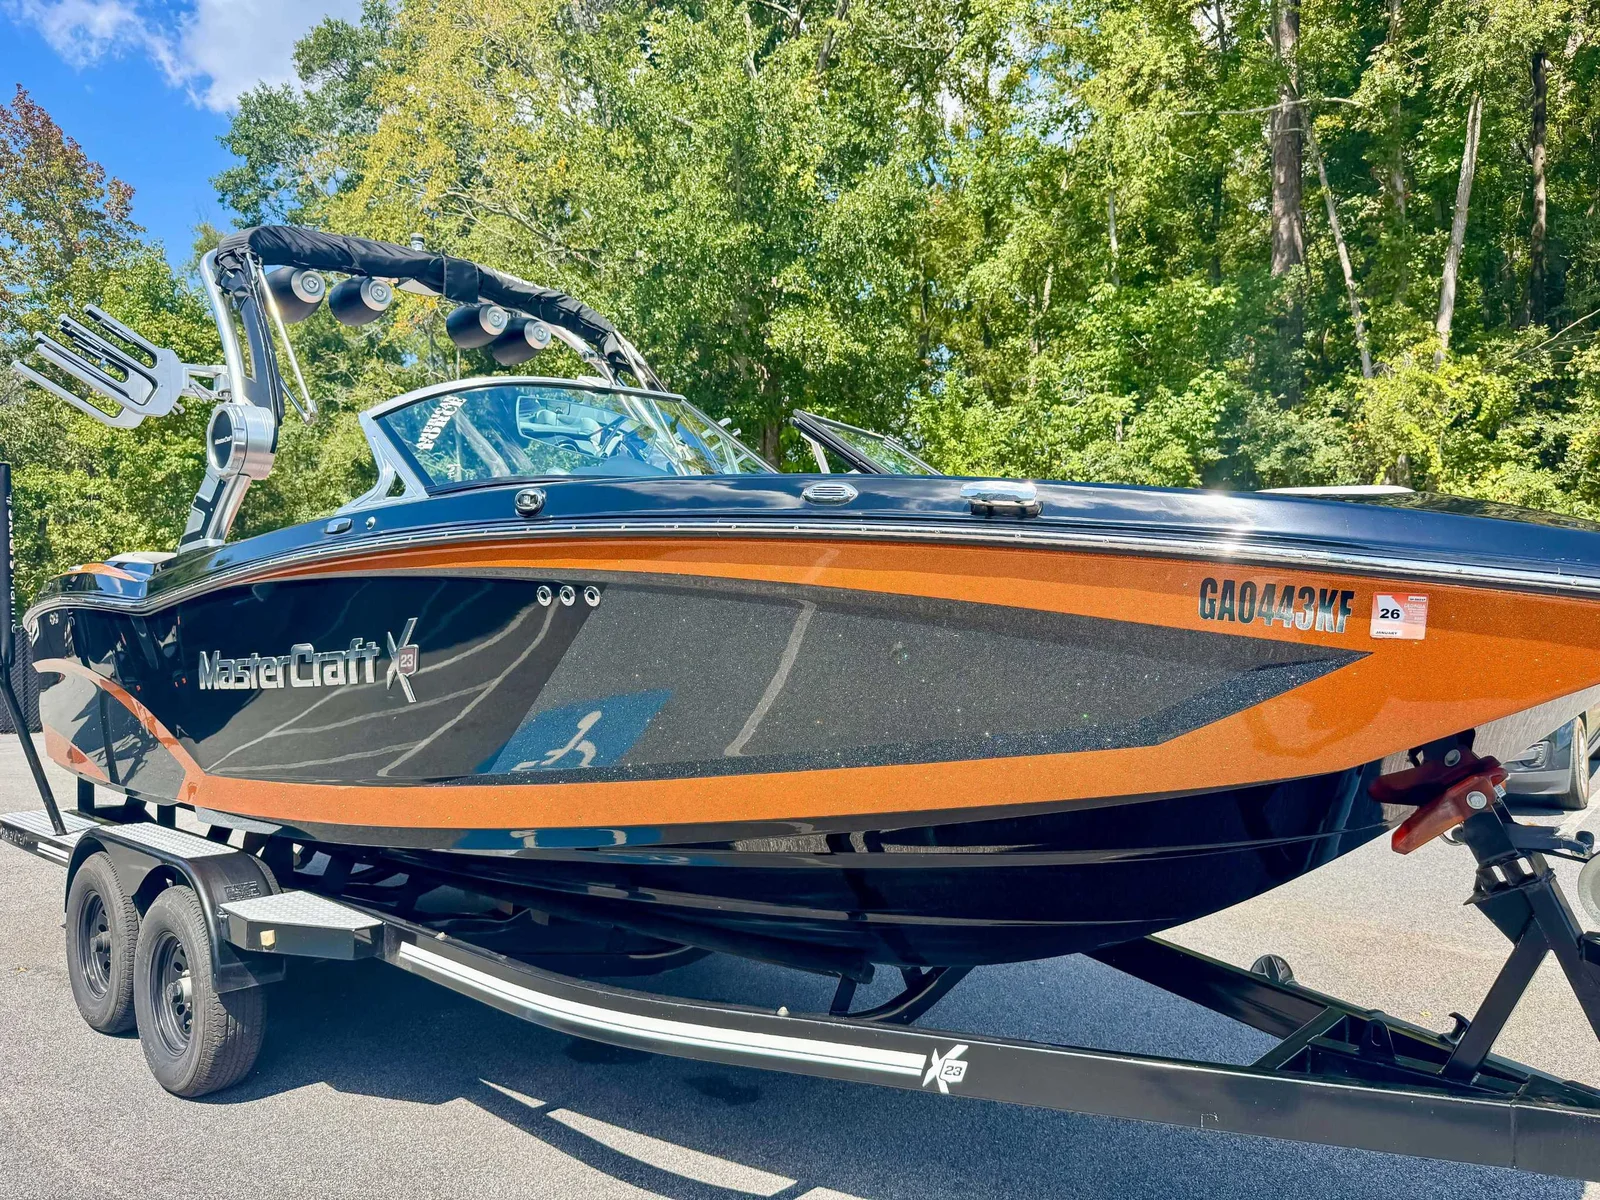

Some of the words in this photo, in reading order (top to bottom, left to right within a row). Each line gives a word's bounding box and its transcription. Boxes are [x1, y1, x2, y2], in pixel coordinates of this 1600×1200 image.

[420, 397, 467, 451] FORCE
[1199, 577, 1355, 633] GA0443KF
[1380, 608, 1400, 619] 26
[199, 637, 381, 690] MasterCraft
[400, 652, 414, 668] 23
[944, 1065, 963, 1077] 23
